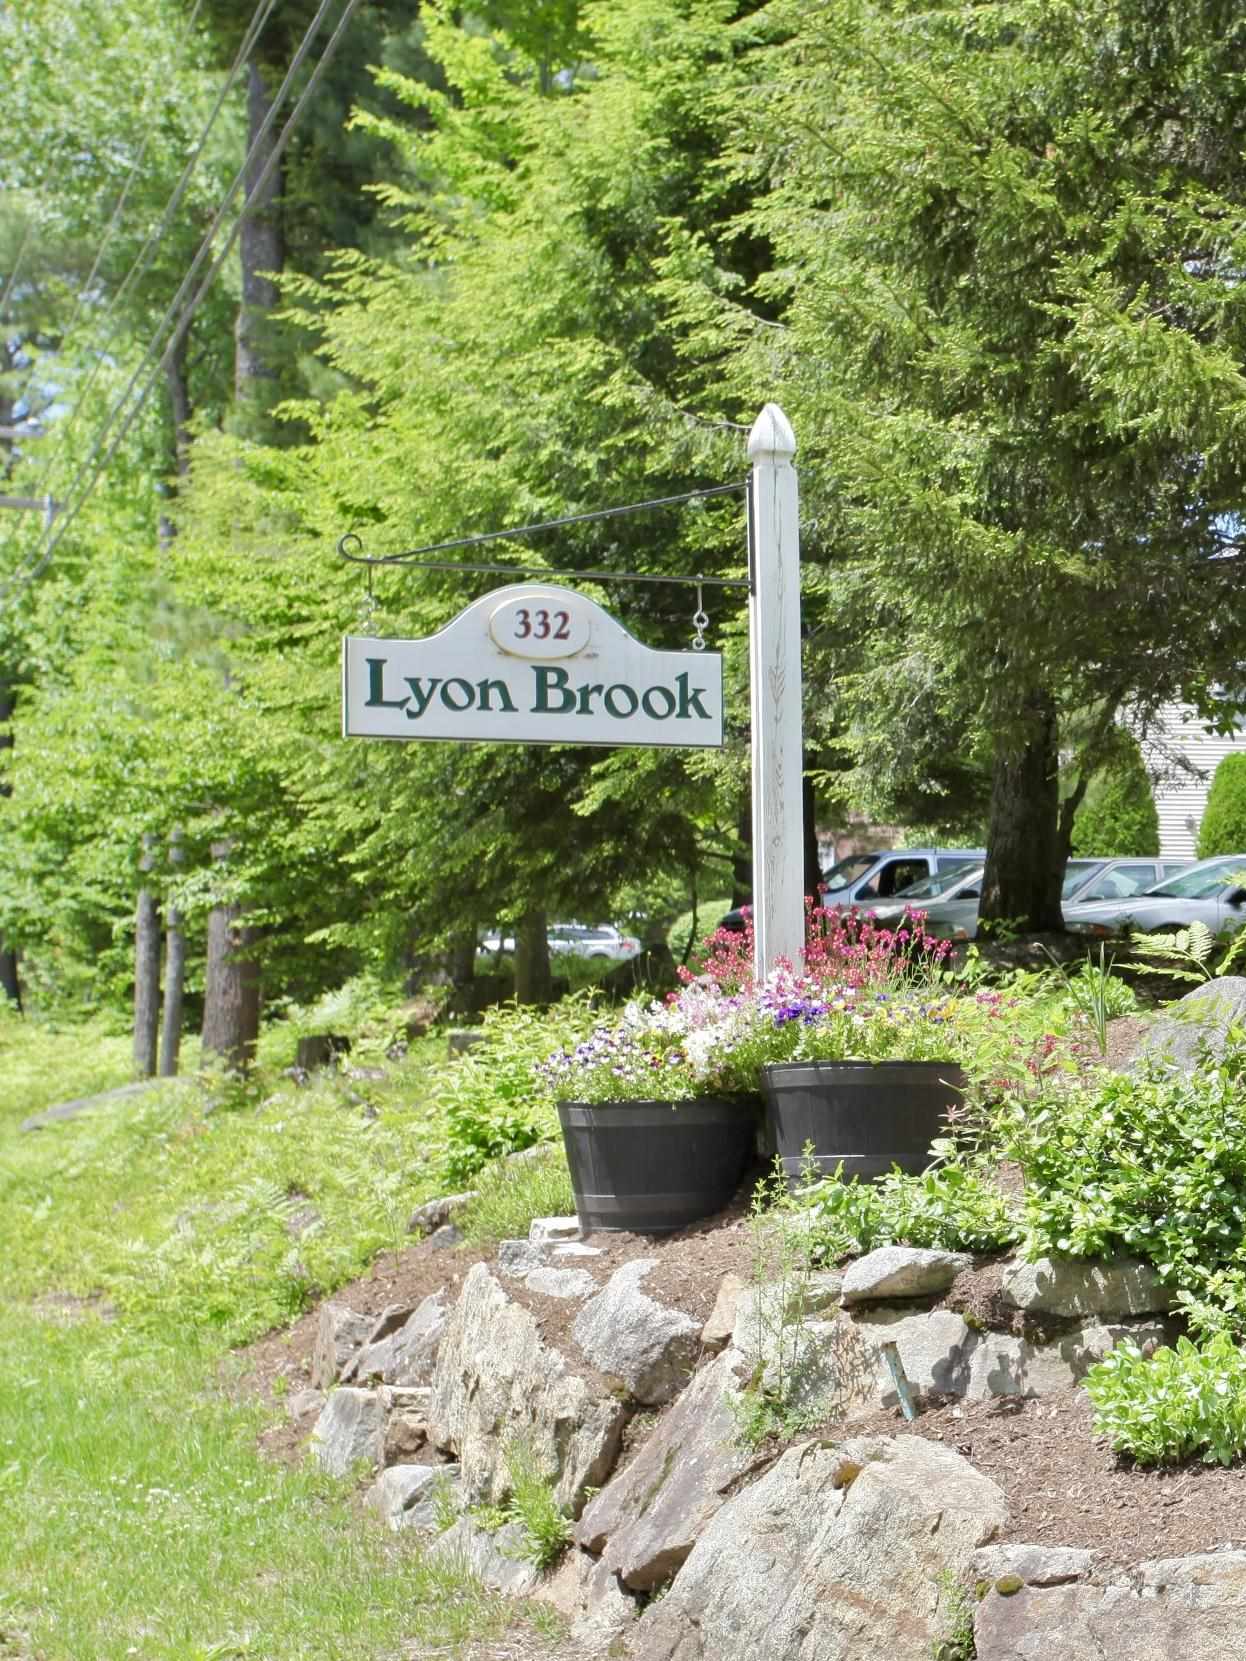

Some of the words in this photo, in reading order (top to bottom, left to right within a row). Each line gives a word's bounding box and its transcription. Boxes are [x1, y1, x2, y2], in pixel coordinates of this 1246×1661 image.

[514, 609, 570, 641] 332
[365, 658, 519, 720] Lyon
[530, 665, 712, 721] Brook
